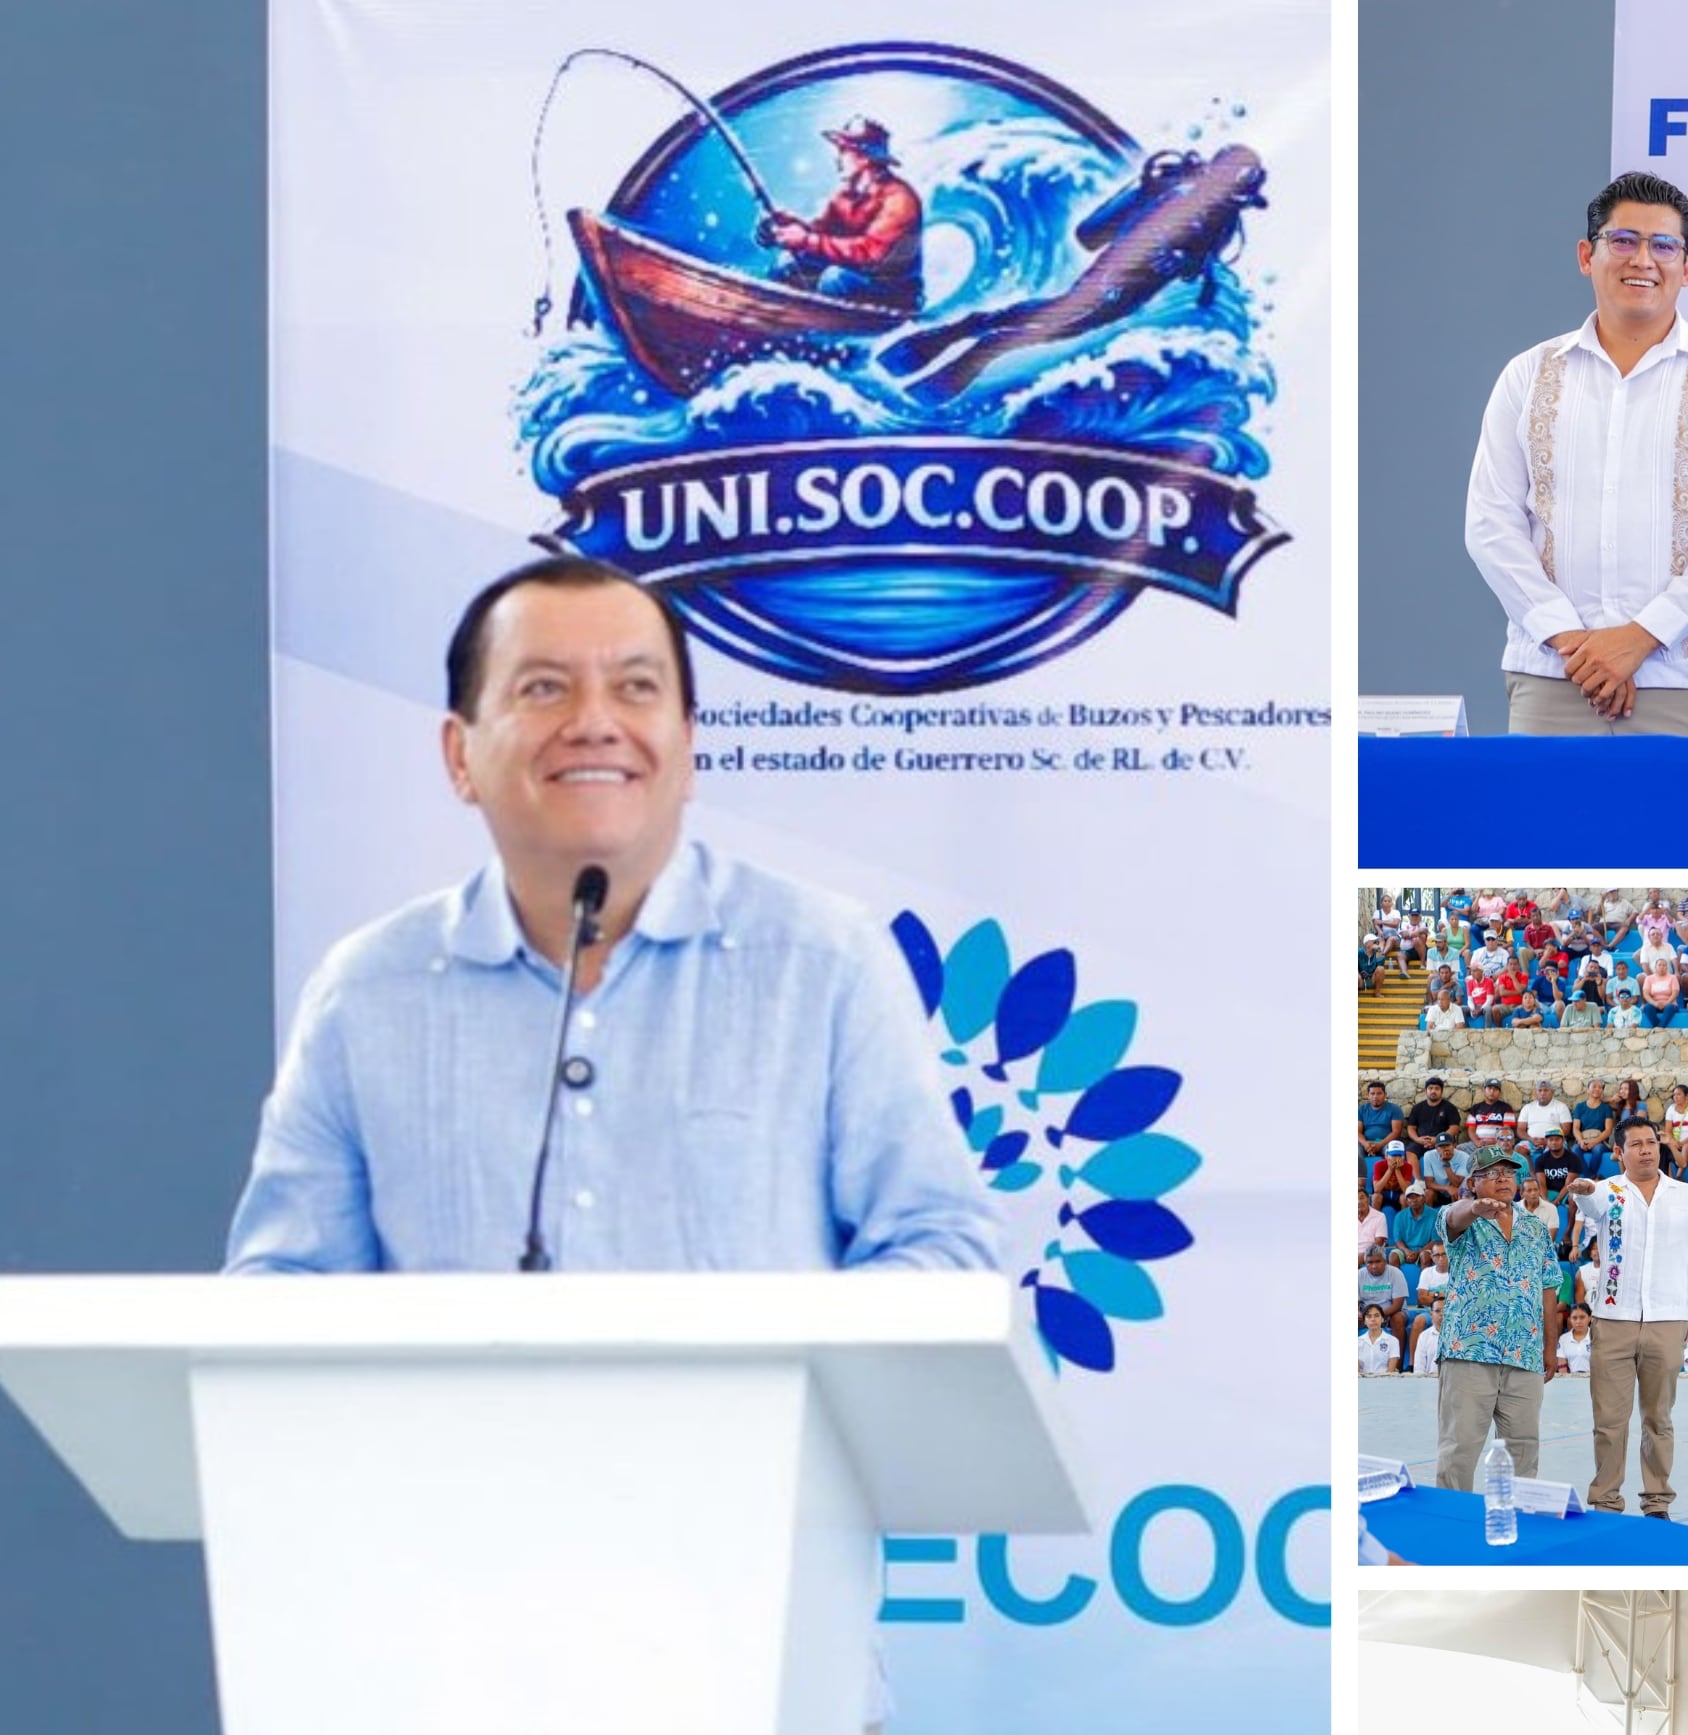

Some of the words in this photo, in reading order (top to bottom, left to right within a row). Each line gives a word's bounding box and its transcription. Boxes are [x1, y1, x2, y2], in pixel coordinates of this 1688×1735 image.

[620, 465, 1199, 553] UNI.SOC.COOP.
[694, 702, 842, 727] ociedades
[850, 702, 1032, 733] Cooperativas
[1037, 706, 1063, 727] de
[1069, 703, 1150, 727] Buzos
[1154, 708, 1173, 734] y
[1180, 701, 1331, 727] Pescadores
[718, 746, 744, 771] el
[752, 746, 845, 771] estado
[852, 746, 886, 771] de
[894, 748, 1025, 771] Guerrero
[1073, 747, 1105, 771] de
[1161, 747, 1194, 771] de
[1544, 1167, 1569, 1177] BOSS
